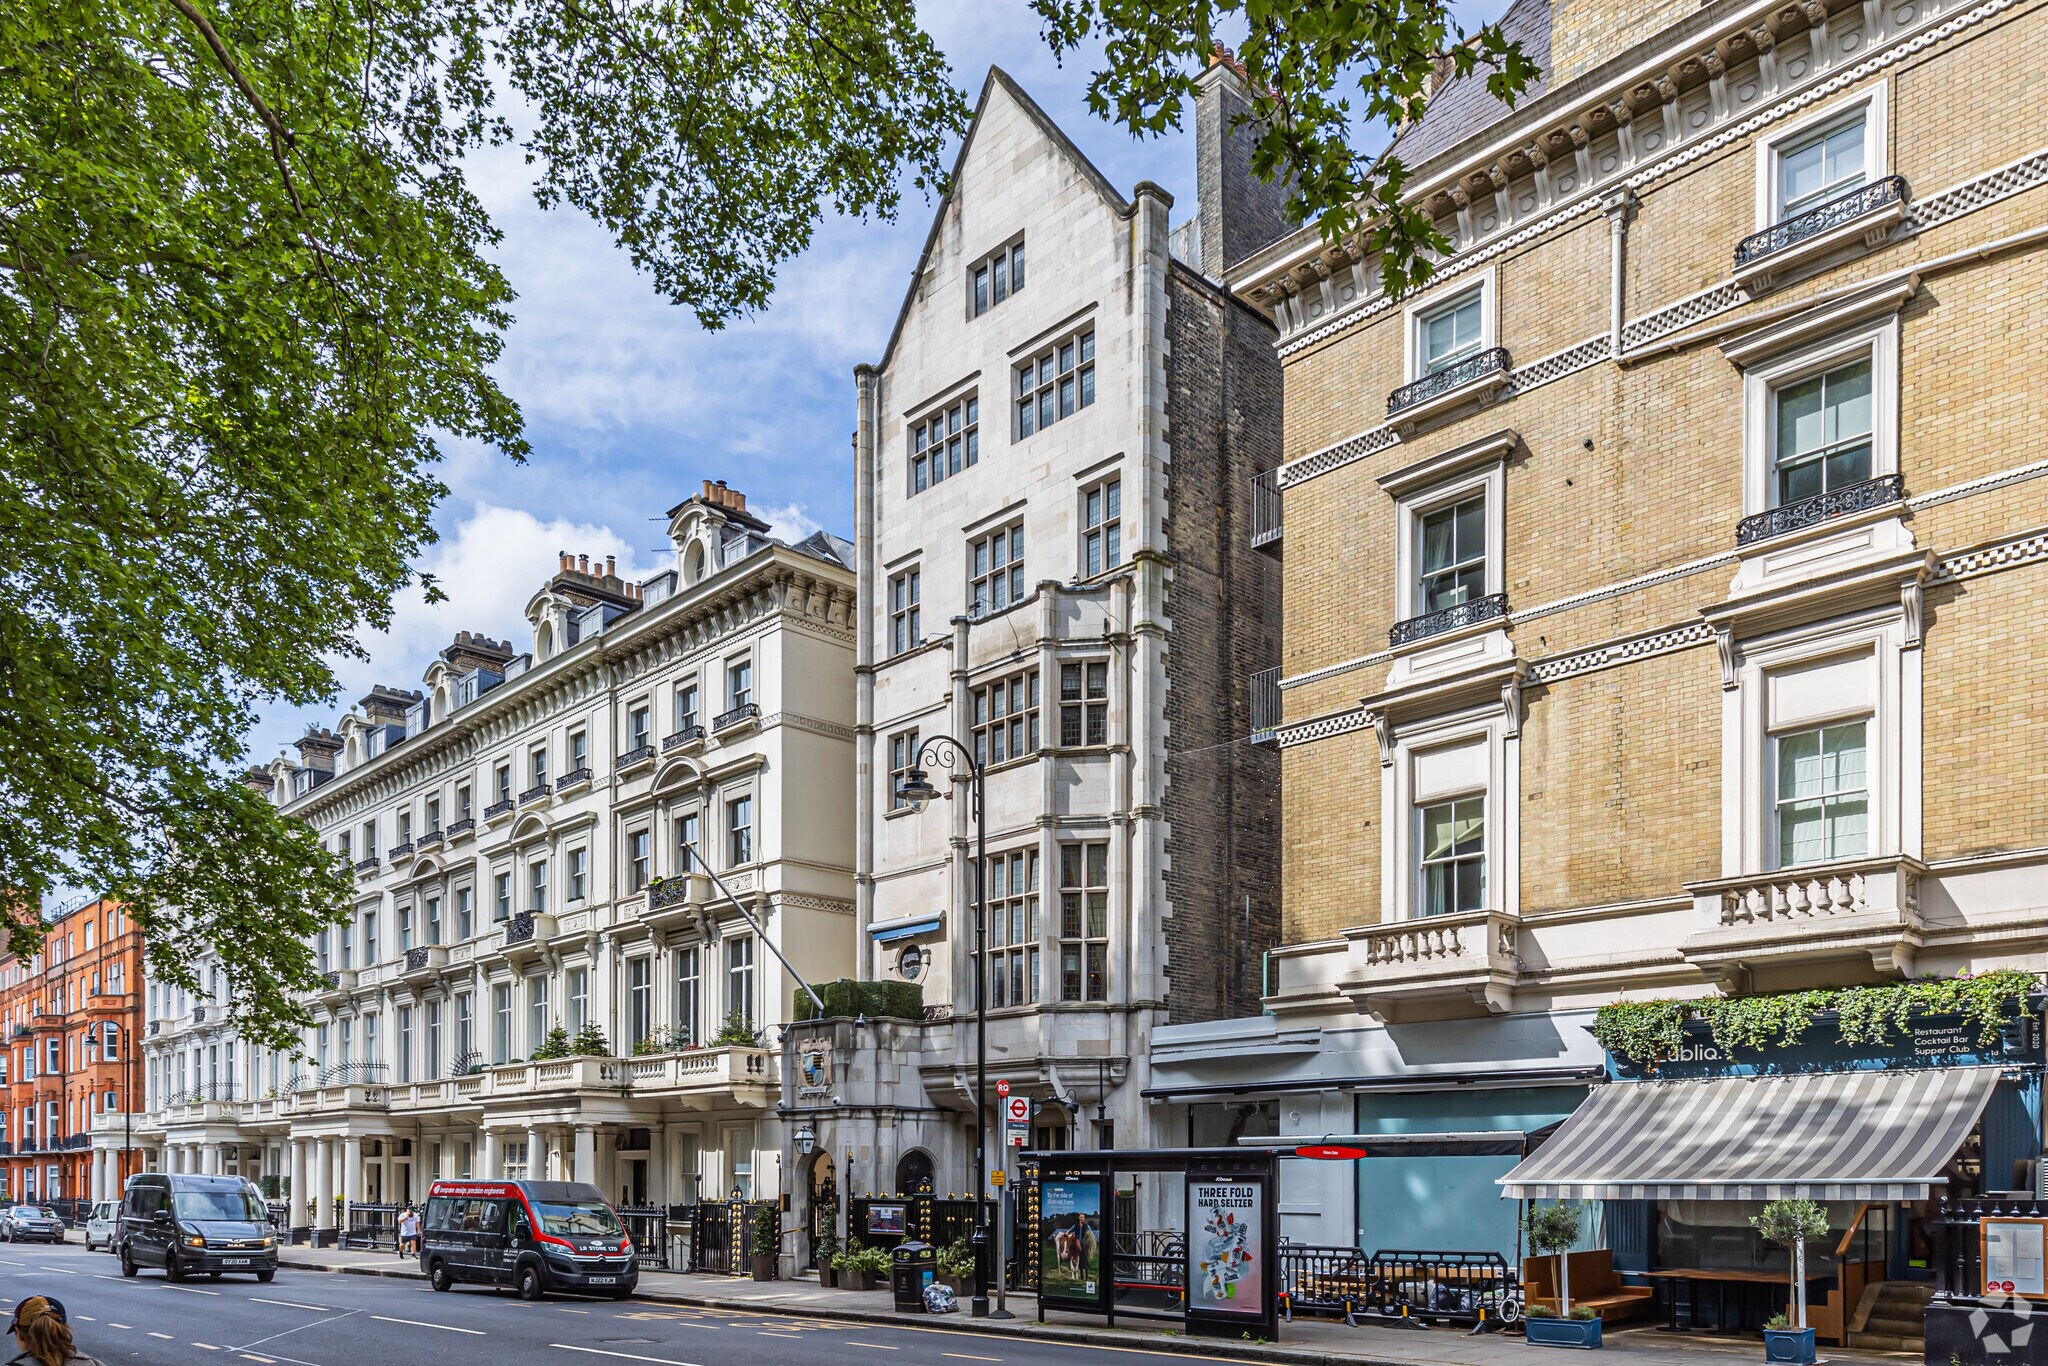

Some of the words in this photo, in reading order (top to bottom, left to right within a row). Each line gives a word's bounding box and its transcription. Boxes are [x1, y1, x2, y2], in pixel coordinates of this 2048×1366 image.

[1914, 1026, 1963, 1036] Restaurant
[1914, 1036, 1951, 1046] Cocktail
[1953, 1035, 1969, 1044] Bar
[2032, 1033, 2040, 1049] 2020
[1914, 1047, 1946, 1056] Supper
[1949, 1045, 1970, 1053] Club
[998, 1084, 1009, 1092] RQ
[1198, 1187, 1227, 1198] THREE
[1230, 1187, 1253, 1198] FOLD
[1198, 1199, 1220, 1208] HARD
[1220, 1199, 1253, 1208] SELTZER
